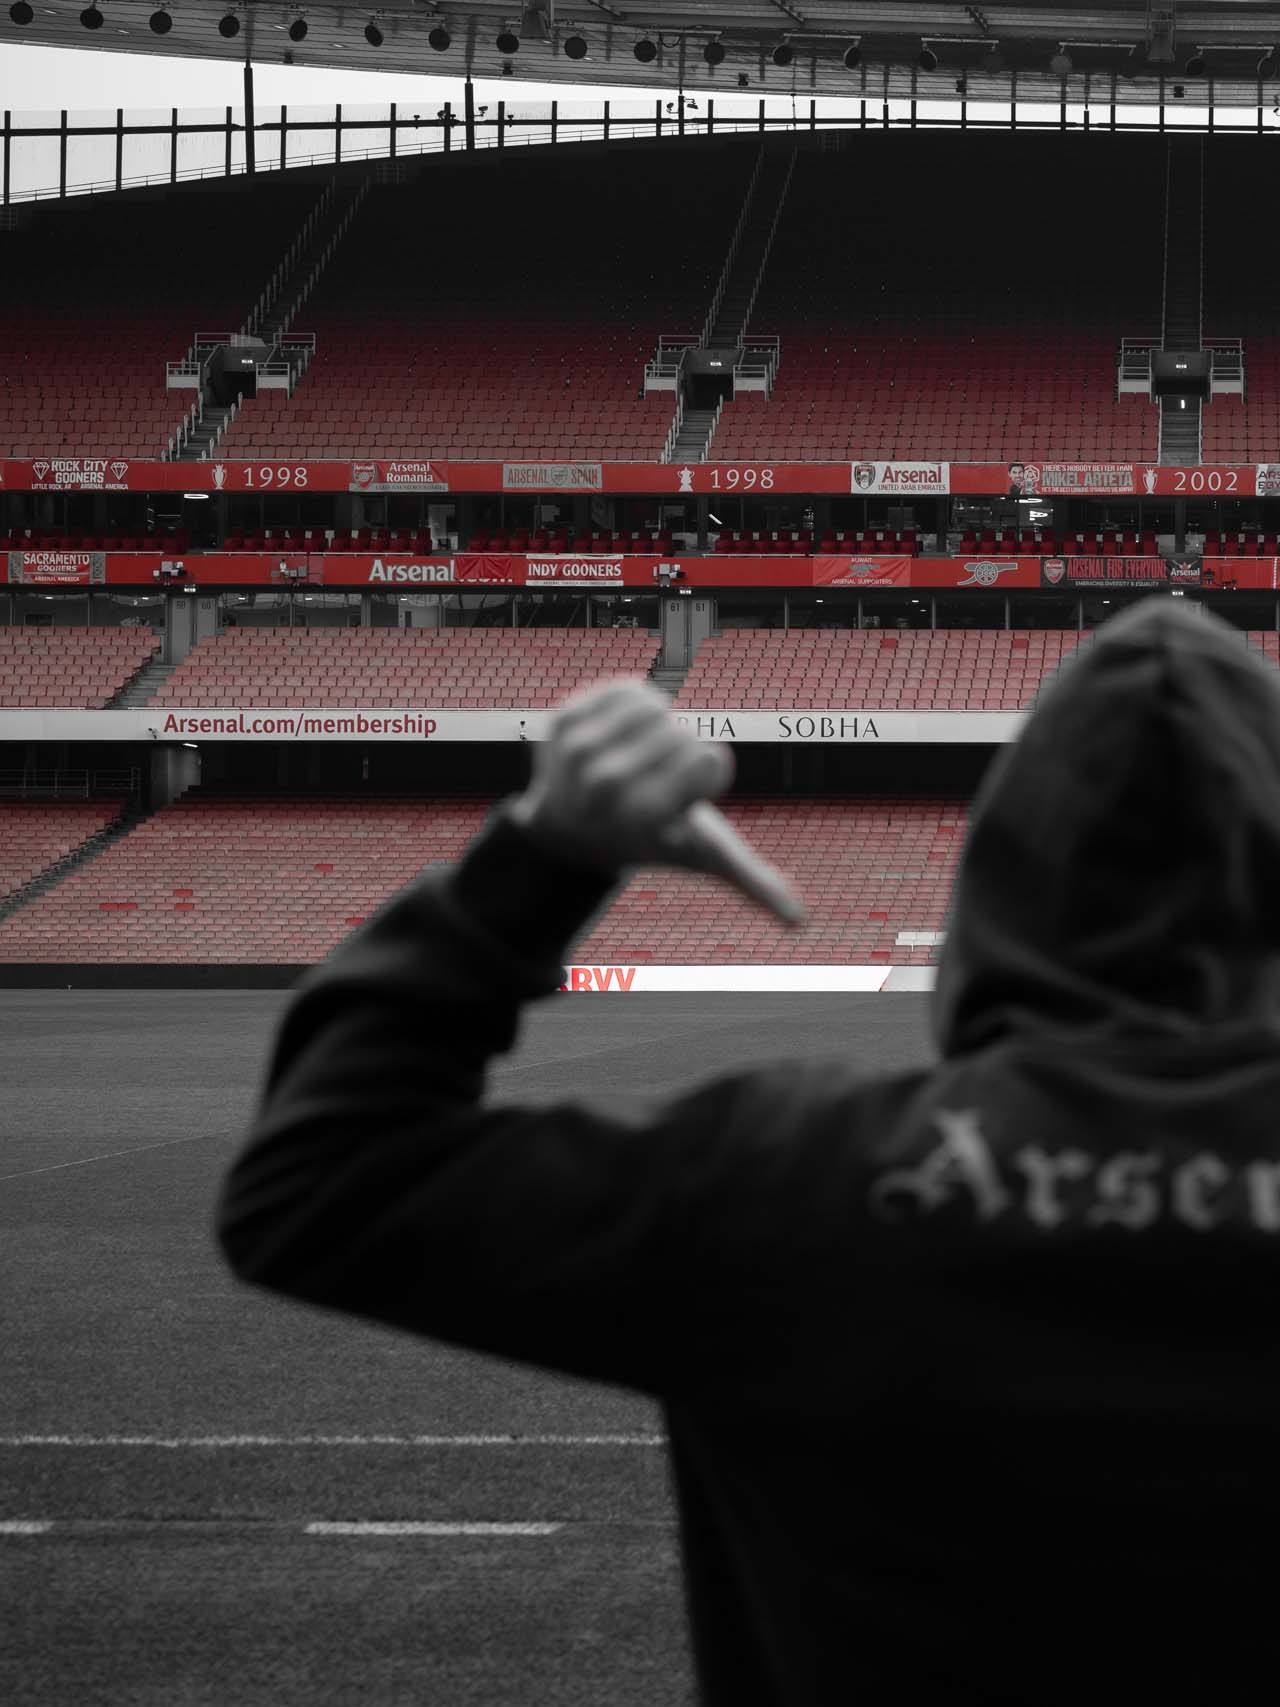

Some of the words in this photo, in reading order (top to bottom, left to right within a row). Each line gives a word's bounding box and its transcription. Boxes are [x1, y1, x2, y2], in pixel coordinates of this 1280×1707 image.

[51, 460, 80, 472] ROCK
[83, 460, 109, 472] CITY
[389, 462, 430, 472] Arsenal
[55, 472, 105, 483] GOONERS
[243, 467, 308, 488] 1998
[386, 472, 433, 483] Romania
[508, 468, 549, 484] ARSENAL
[571, 468, 598, 485] SPAIN
[710, 469, 774, 490] 1998
[881, 465, 942, 483] Arsenal
[1042, 472, 1081, 487] MIKEL
[1084, 472, 1133, 487] ARTETA
[1174, 472, 1238, 491] 2002
[24, 553, 90, 565] SACRAMENTO
[528, 564, 558, 577] INDY
[562, 563, 622, 577] GOONERS
[1067, 558, 1105, 579] ARSENAL
[1107, 558, 1123, 579] FOR
[1125, 558, 1169, 579] EVERYONE
[1170, 567, 1201, 576] Arsenal
[671, 602, 680, 612] 61
[163, 713, 437, 738] Arsenal.com/membership
[778, 716, 880, 738] SOBHA
